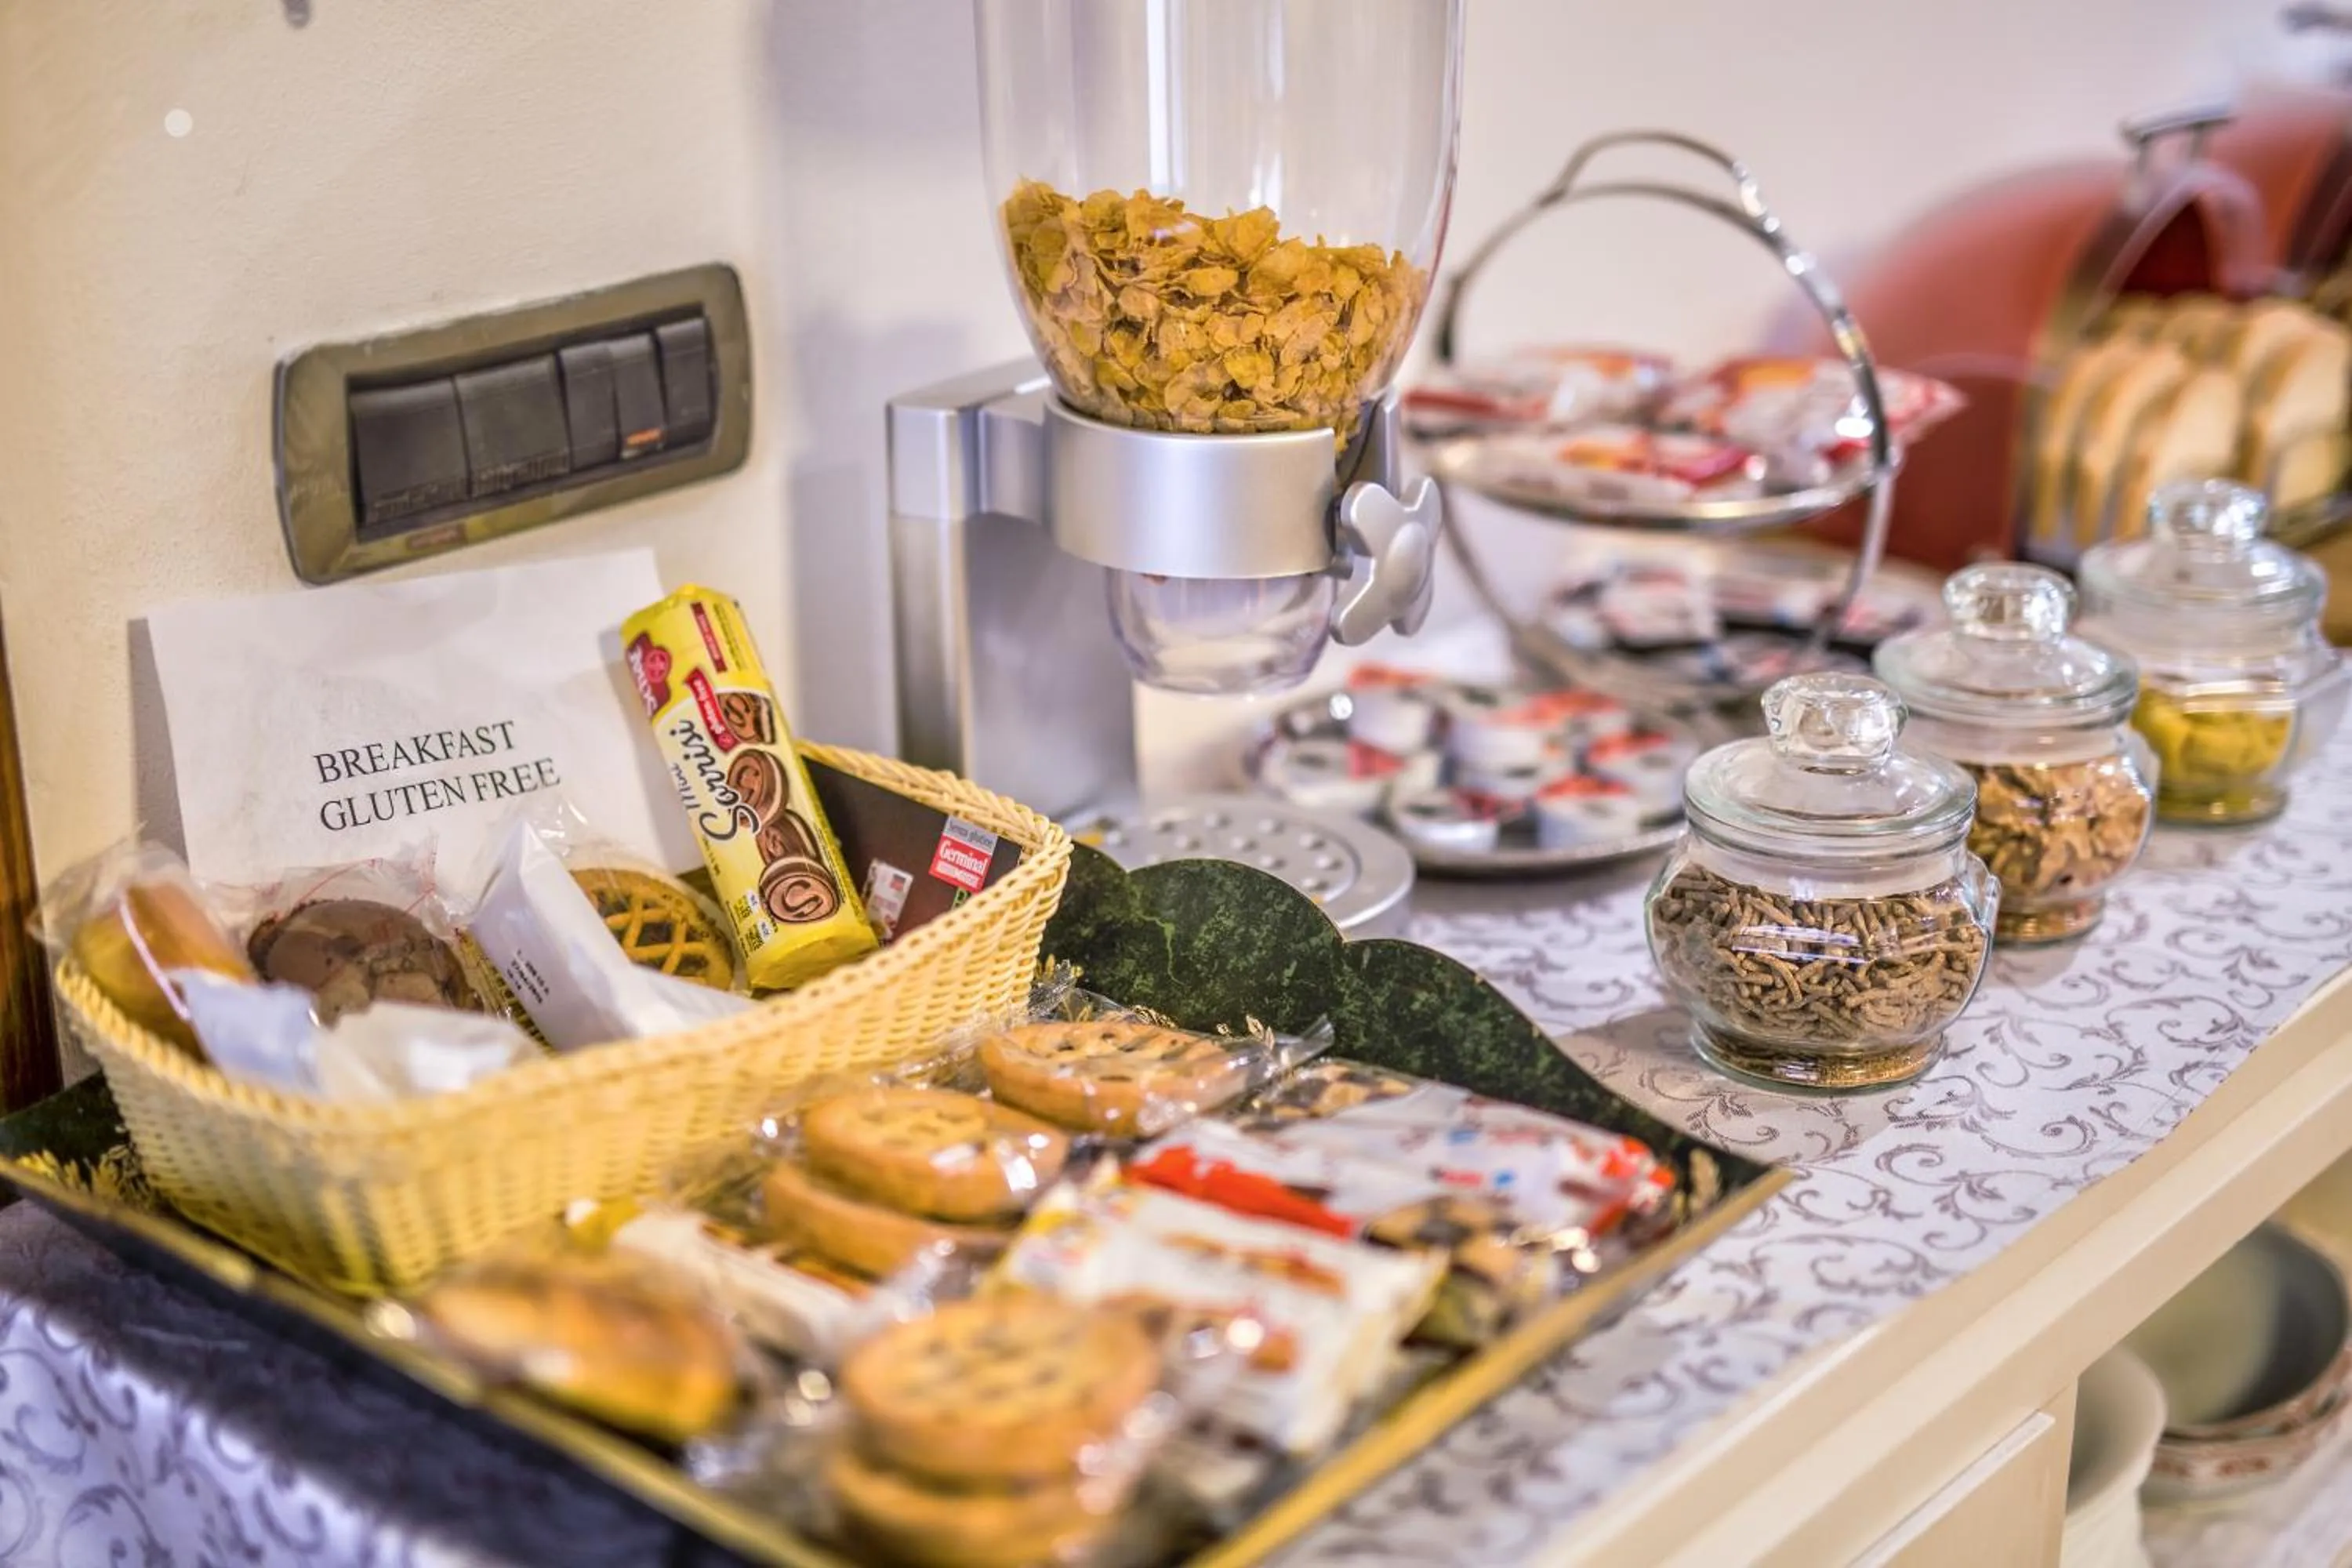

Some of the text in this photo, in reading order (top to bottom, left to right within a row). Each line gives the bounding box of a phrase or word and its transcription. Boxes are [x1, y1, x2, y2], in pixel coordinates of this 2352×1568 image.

[313, 720, 515, 784] BREAKFAST
[670, 719, 760, 841] Sorrisi
[320, 757, 561, 832] GLUTEN FREE
